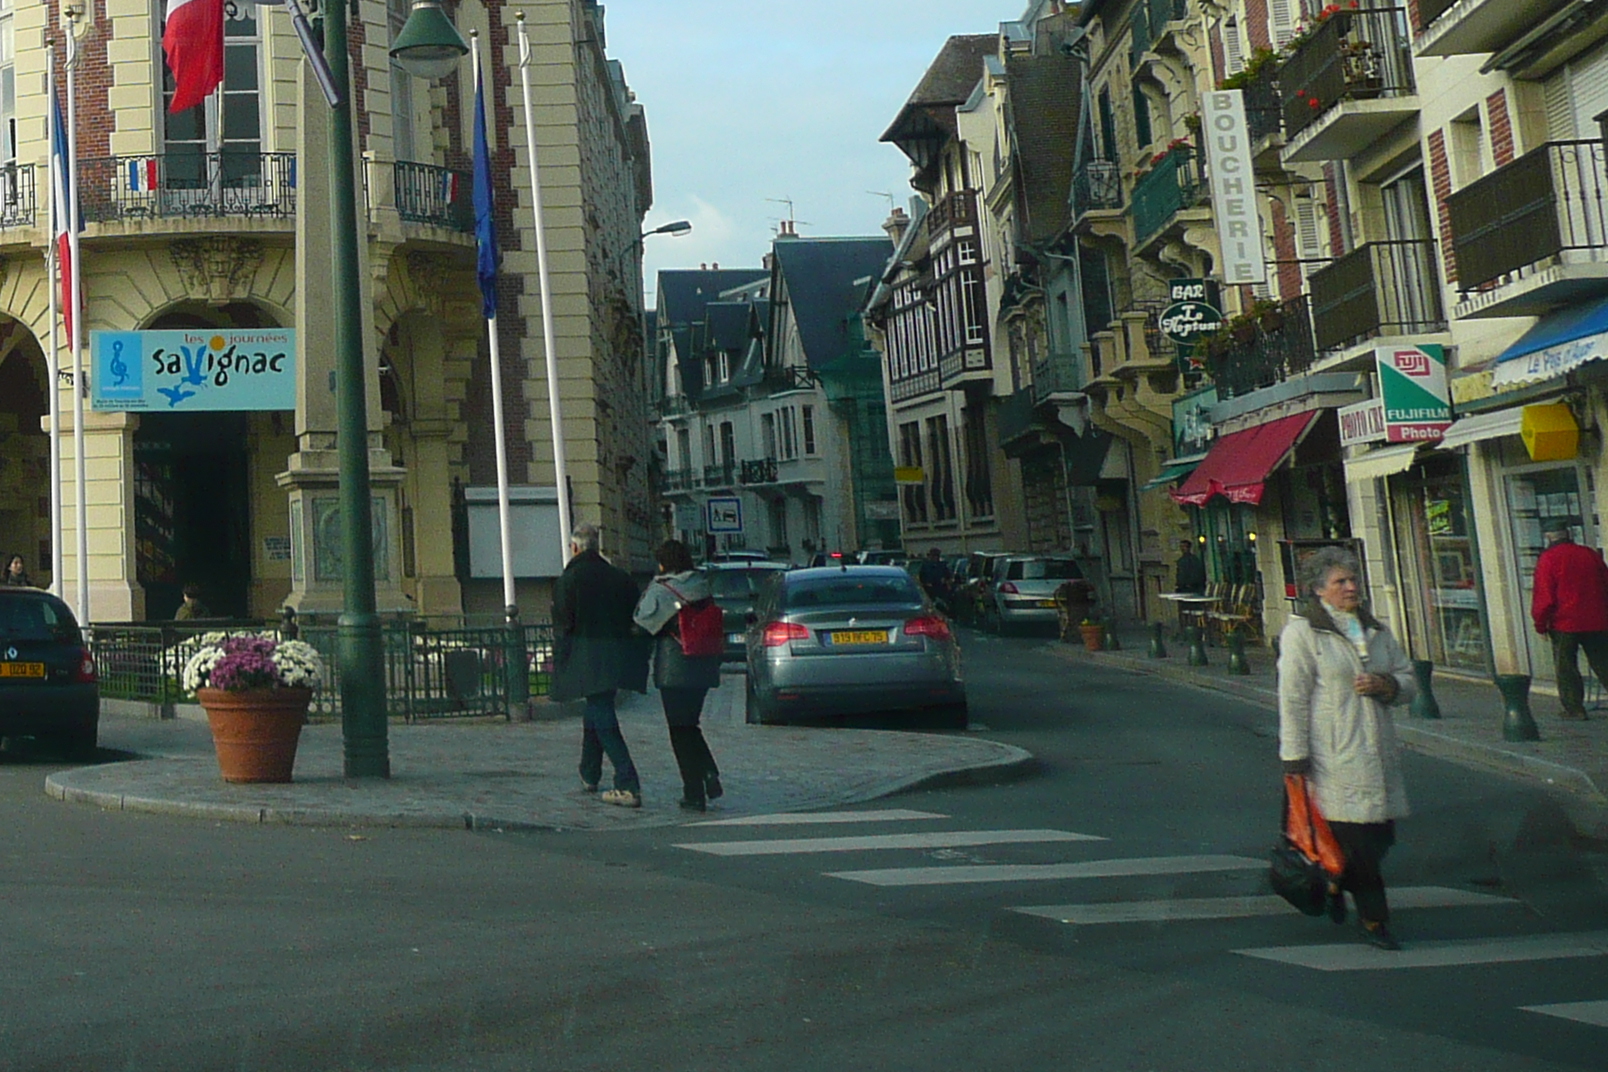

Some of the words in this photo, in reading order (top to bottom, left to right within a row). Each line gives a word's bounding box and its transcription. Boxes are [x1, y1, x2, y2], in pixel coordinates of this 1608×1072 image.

[1212, 93, 1254, 280] BOUCHERIE
[1172, 284, 1204, 300] BAR
[184, 333, 204, 344] les
[228, 333, 288, 345] journées
[1387, 408, 1449, 420] FUJIFILM
[1341, 410, 1368, 440] PHOTO
[1401, 427, 1441, 439] Photo
